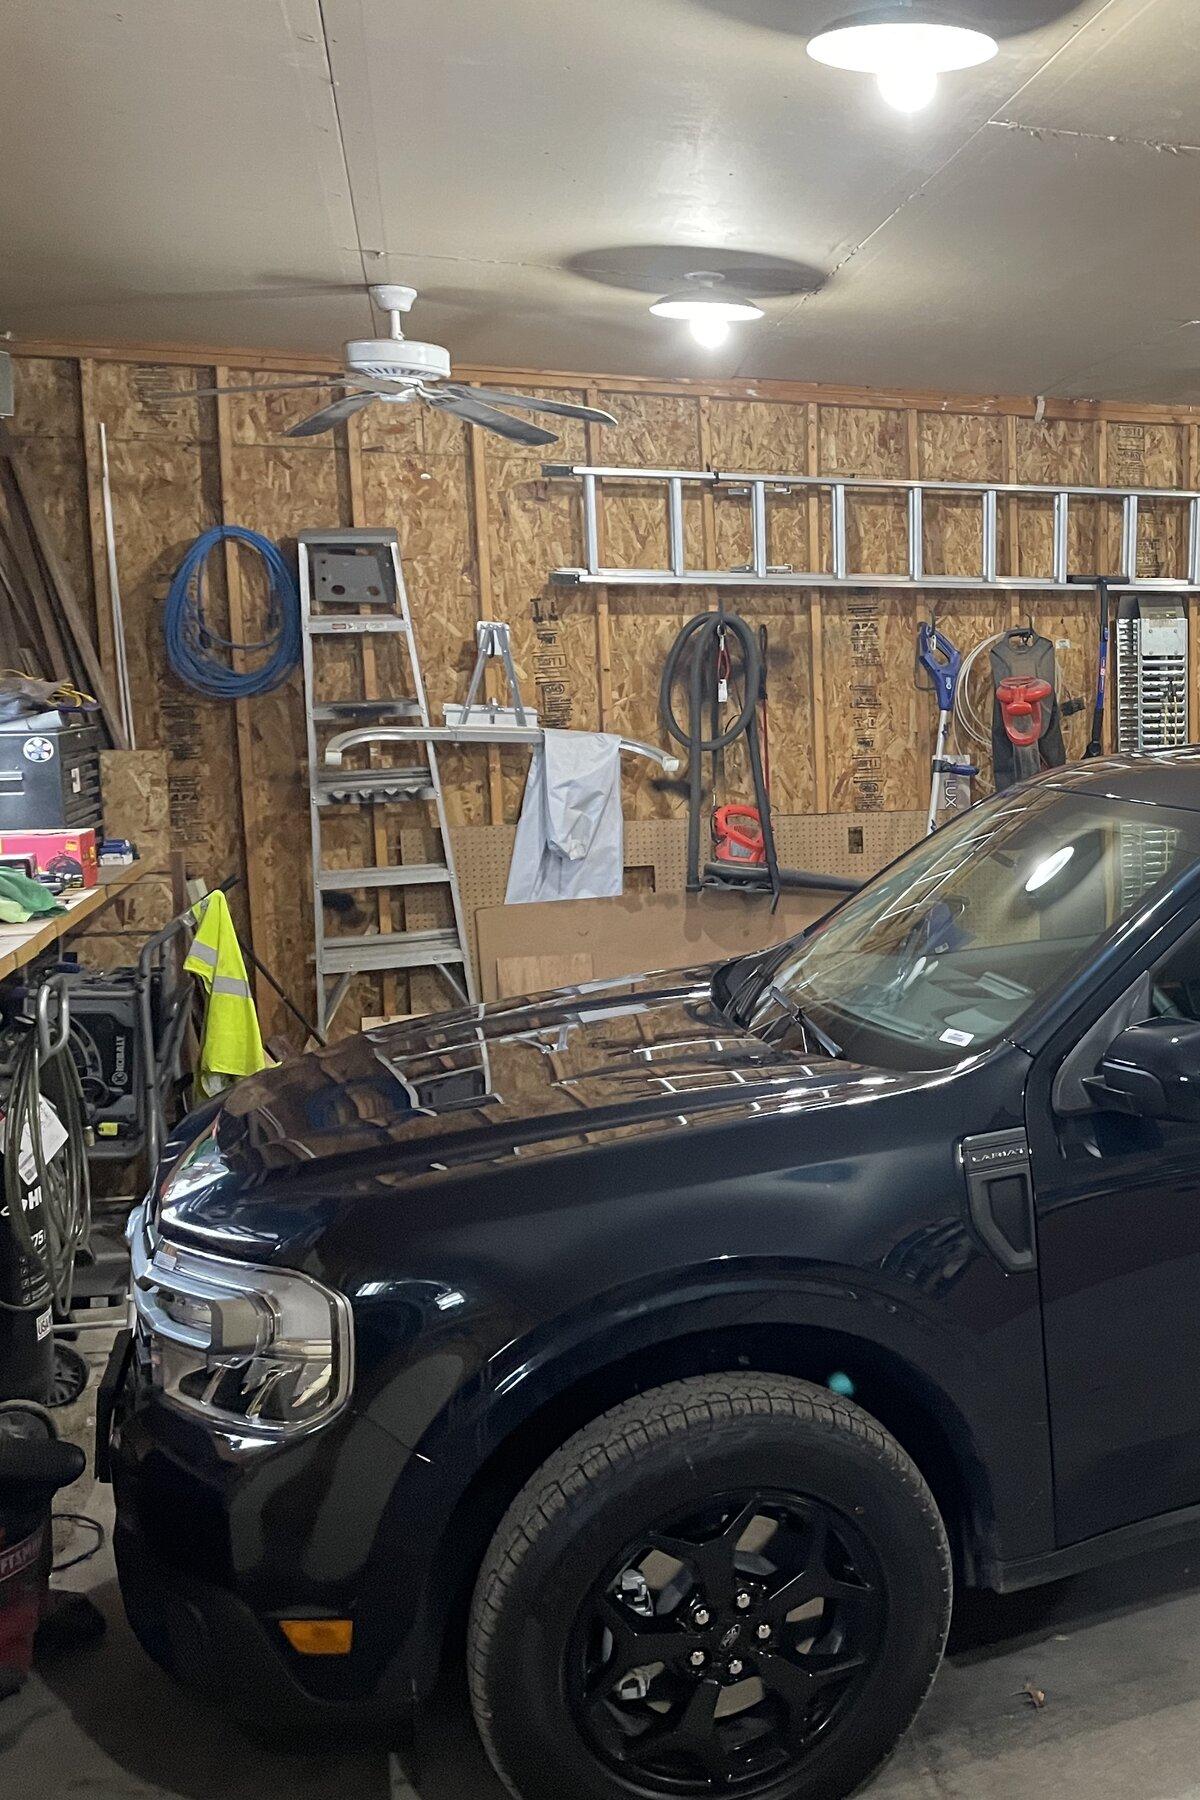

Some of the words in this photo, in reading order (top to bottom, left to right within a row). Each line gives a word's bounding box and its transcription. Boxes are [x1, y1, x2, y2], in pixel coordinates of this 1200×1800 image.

[945, 779, 957, 807] LUX
[115, 1036, 125, 1072] KOBALT
[971, 1147, 1026, 1163] LARIAT
